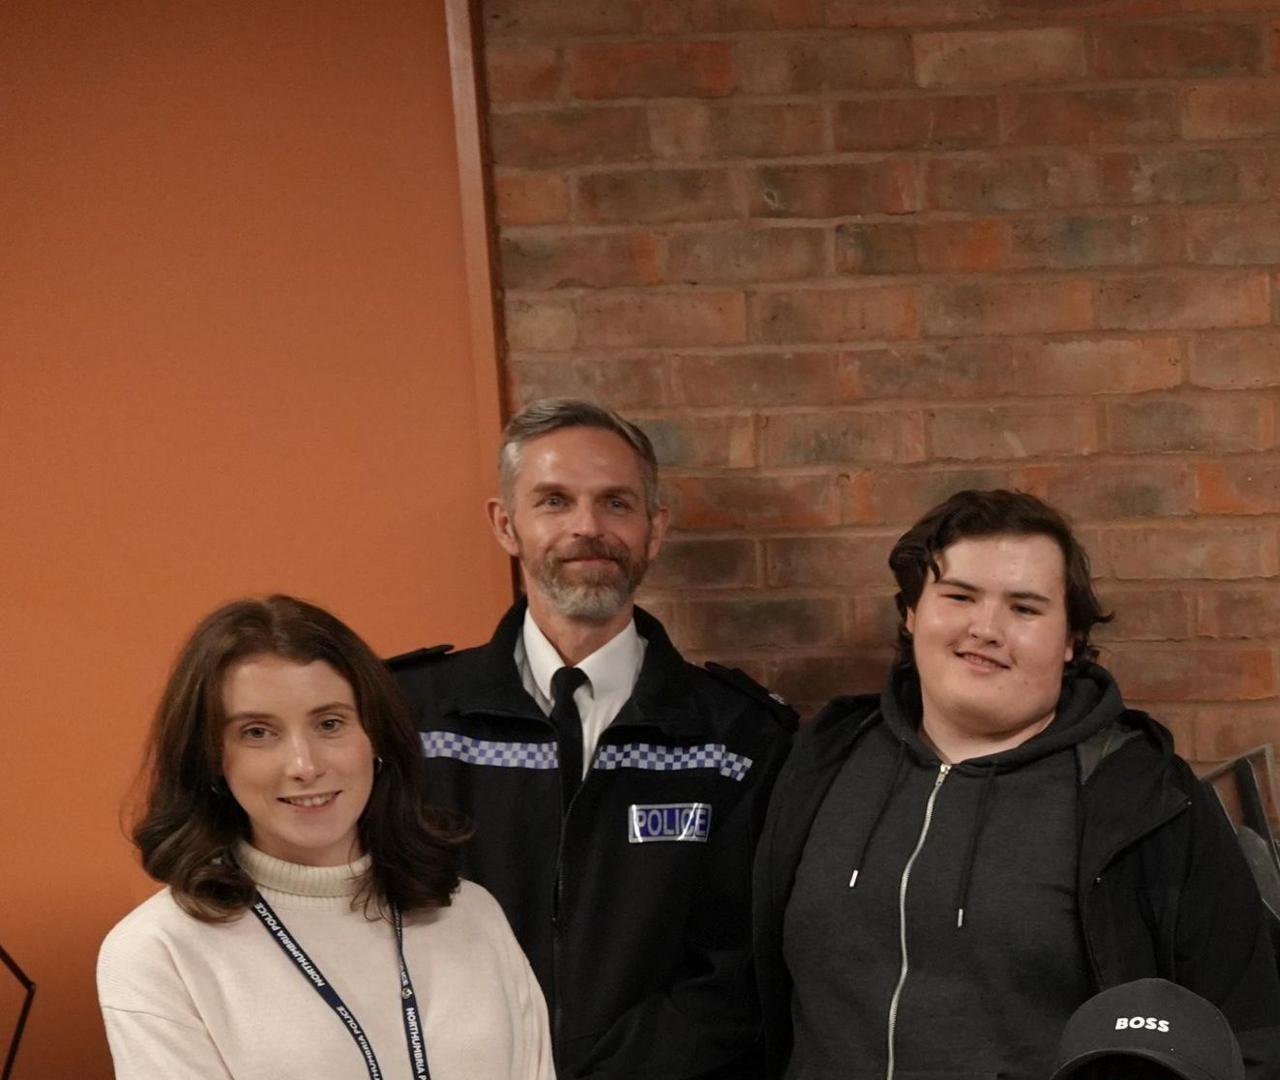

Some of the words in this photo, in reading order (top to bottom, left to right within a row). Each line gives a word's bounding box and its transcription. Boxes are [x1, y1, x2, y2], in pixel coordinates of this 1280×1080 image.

[634, 808, 706, 836] POLICE
[254, 903, 281, 931] POLICE
[277, 930, 326, 987] NORTHUMBRIA
[336, 1006, 361, 1034] POLICE
[1115, 1016, 1170, 1032] BOSS
[406, 1008, 425, 1074] NORTHUMBRIA
